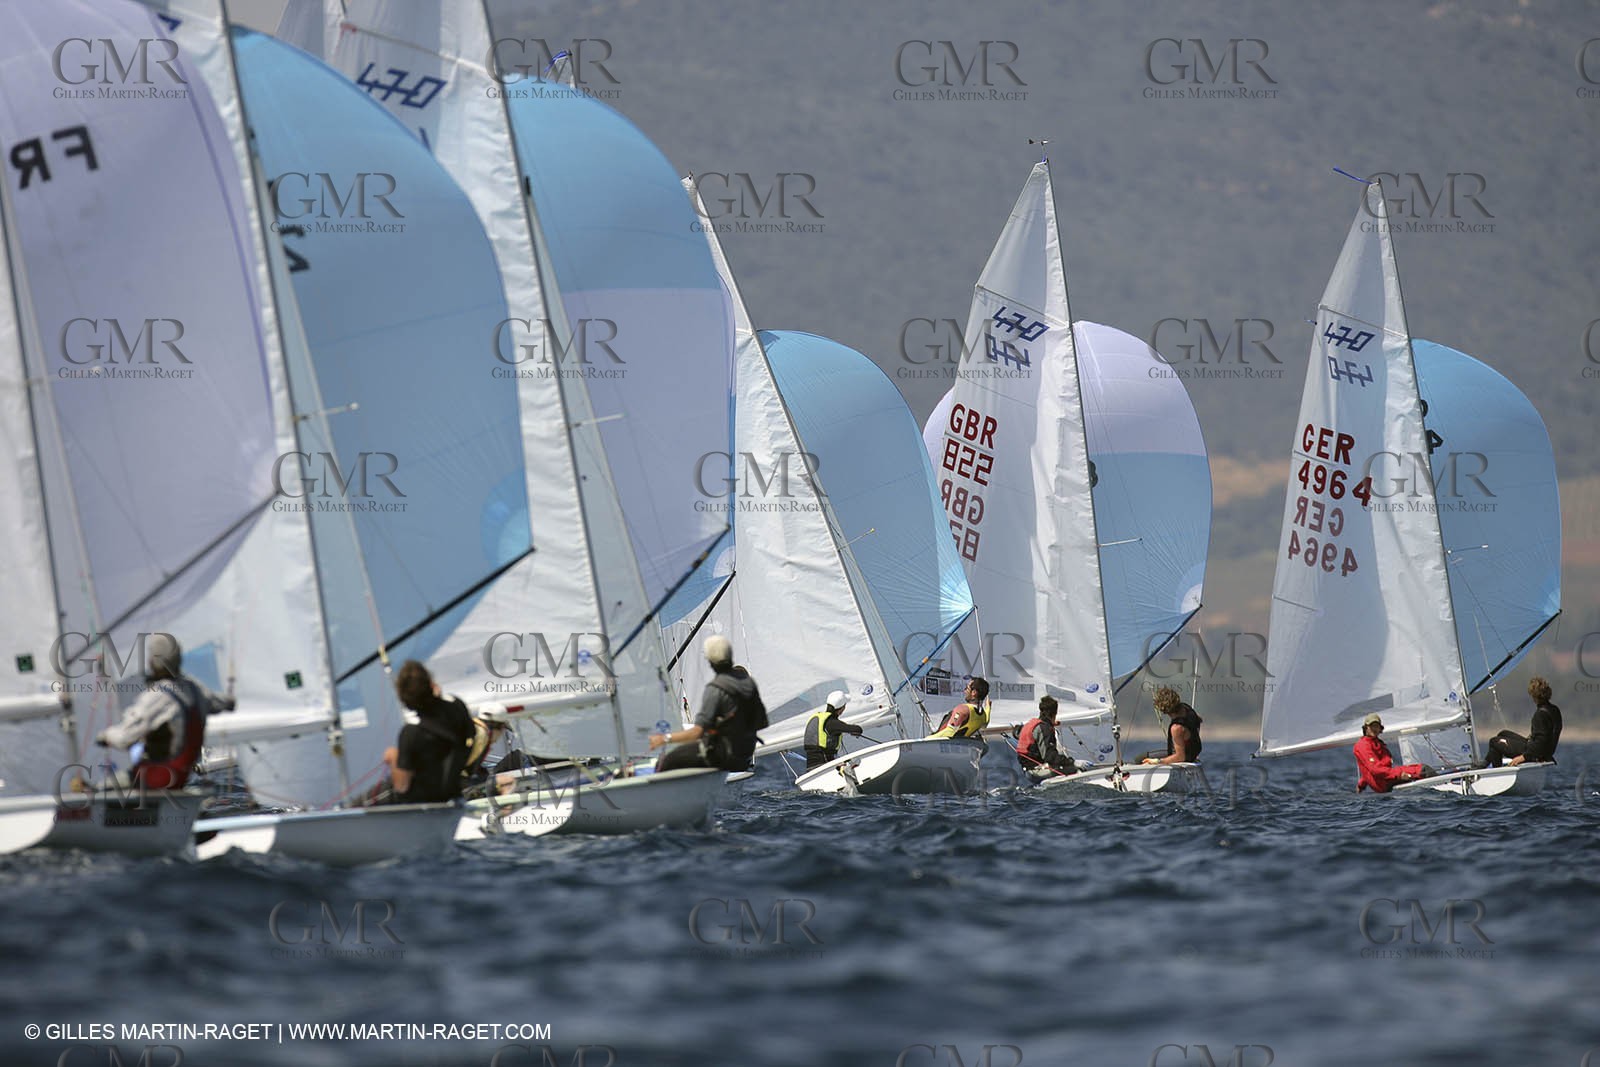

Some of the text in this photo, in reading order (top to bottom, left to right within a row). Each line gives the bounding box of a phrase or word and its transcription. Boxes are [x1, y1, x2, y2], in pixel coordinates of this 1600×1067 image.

[356, 62, 447, 109] 470
[993, 306, 1050, 342] 470
[1324, 322, 1375, 352] 470
[949, 403, 998, 449] GBR
[1302, 423, 1355, 465] GER
[1298, 459, 1373, 507] 4964
